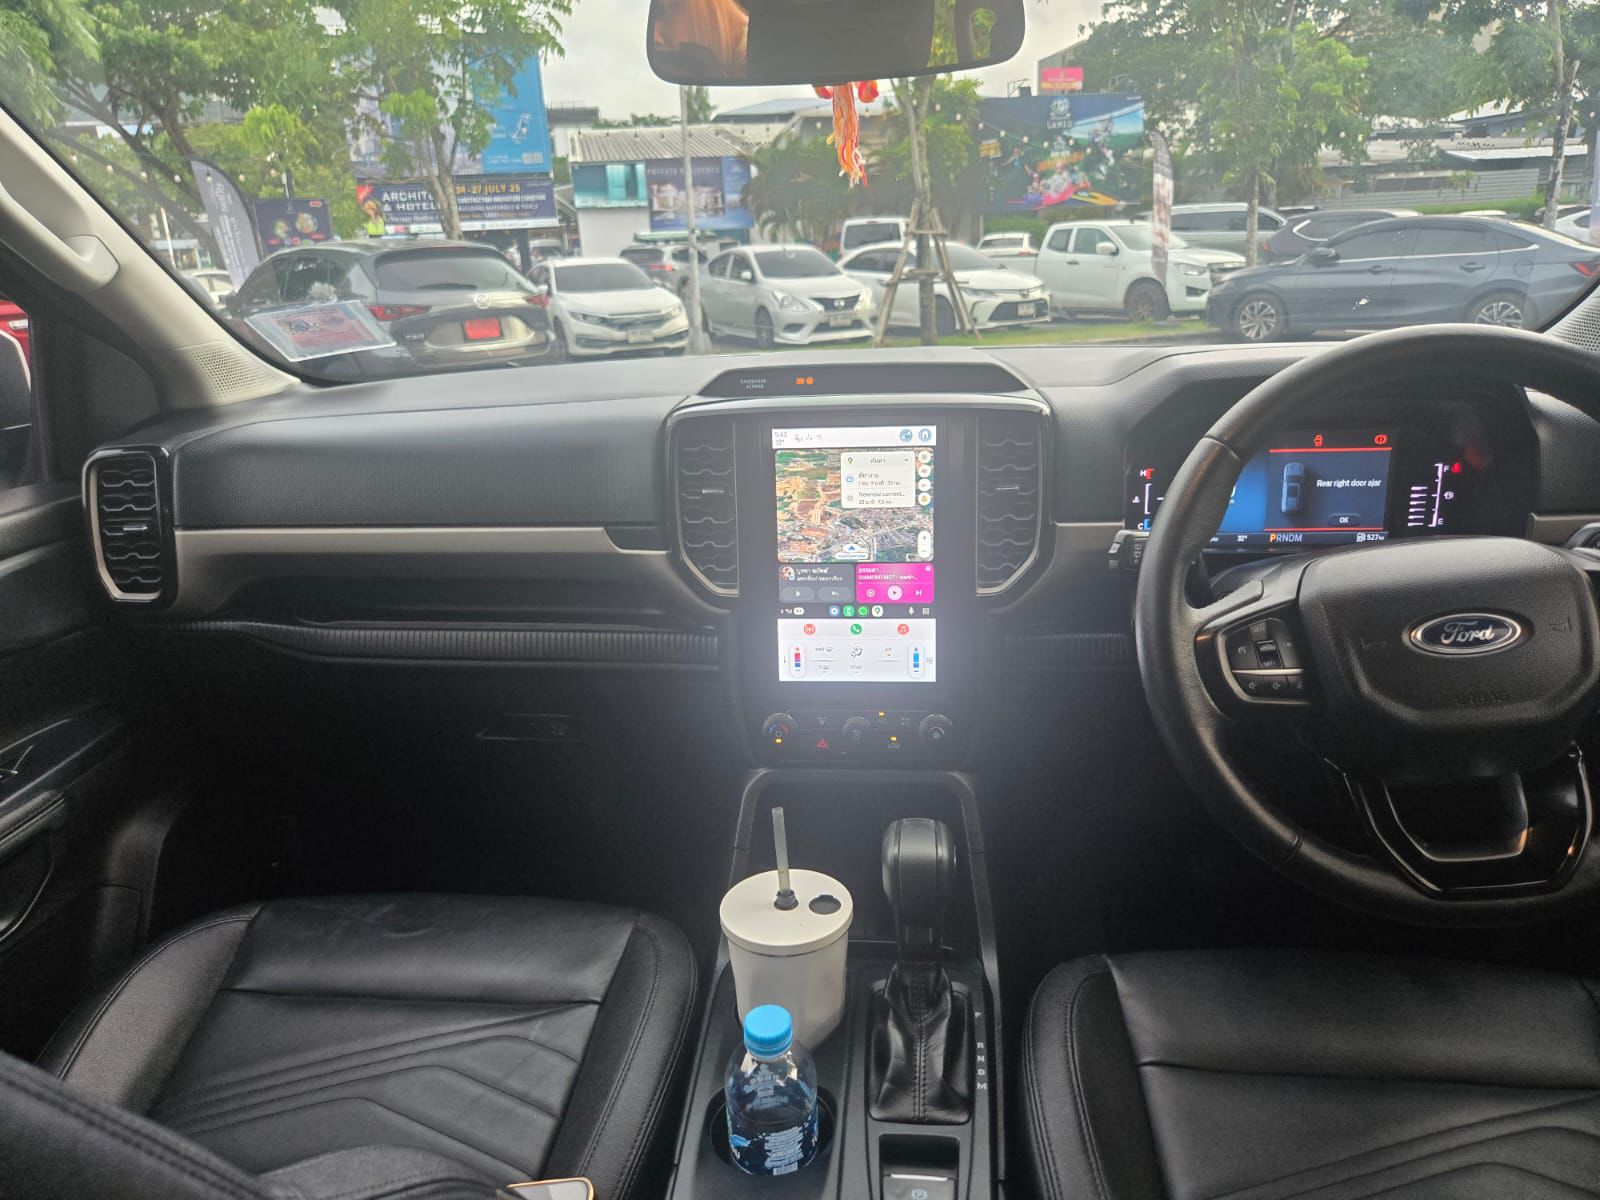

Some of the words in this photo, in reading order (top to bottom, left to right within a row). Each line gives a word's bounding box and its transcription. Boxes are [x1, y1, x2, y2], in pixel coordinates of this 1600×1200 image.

[1316, 479, 1333, 487] Rear
[1333, 479, 1350, 489] right
[1350, 478, 1367, 487] door
[1367, 478, 1382, 488] ajar
[1339, 516, 1350, 524] OK
[1440, 621, 1494, 645] Ford
[977, 1041, 985, 1049] R
[977, 1054, 985, 1062] N
[977, 1068, 985, 1076] D
[976, 1082, 988, 1090] M
